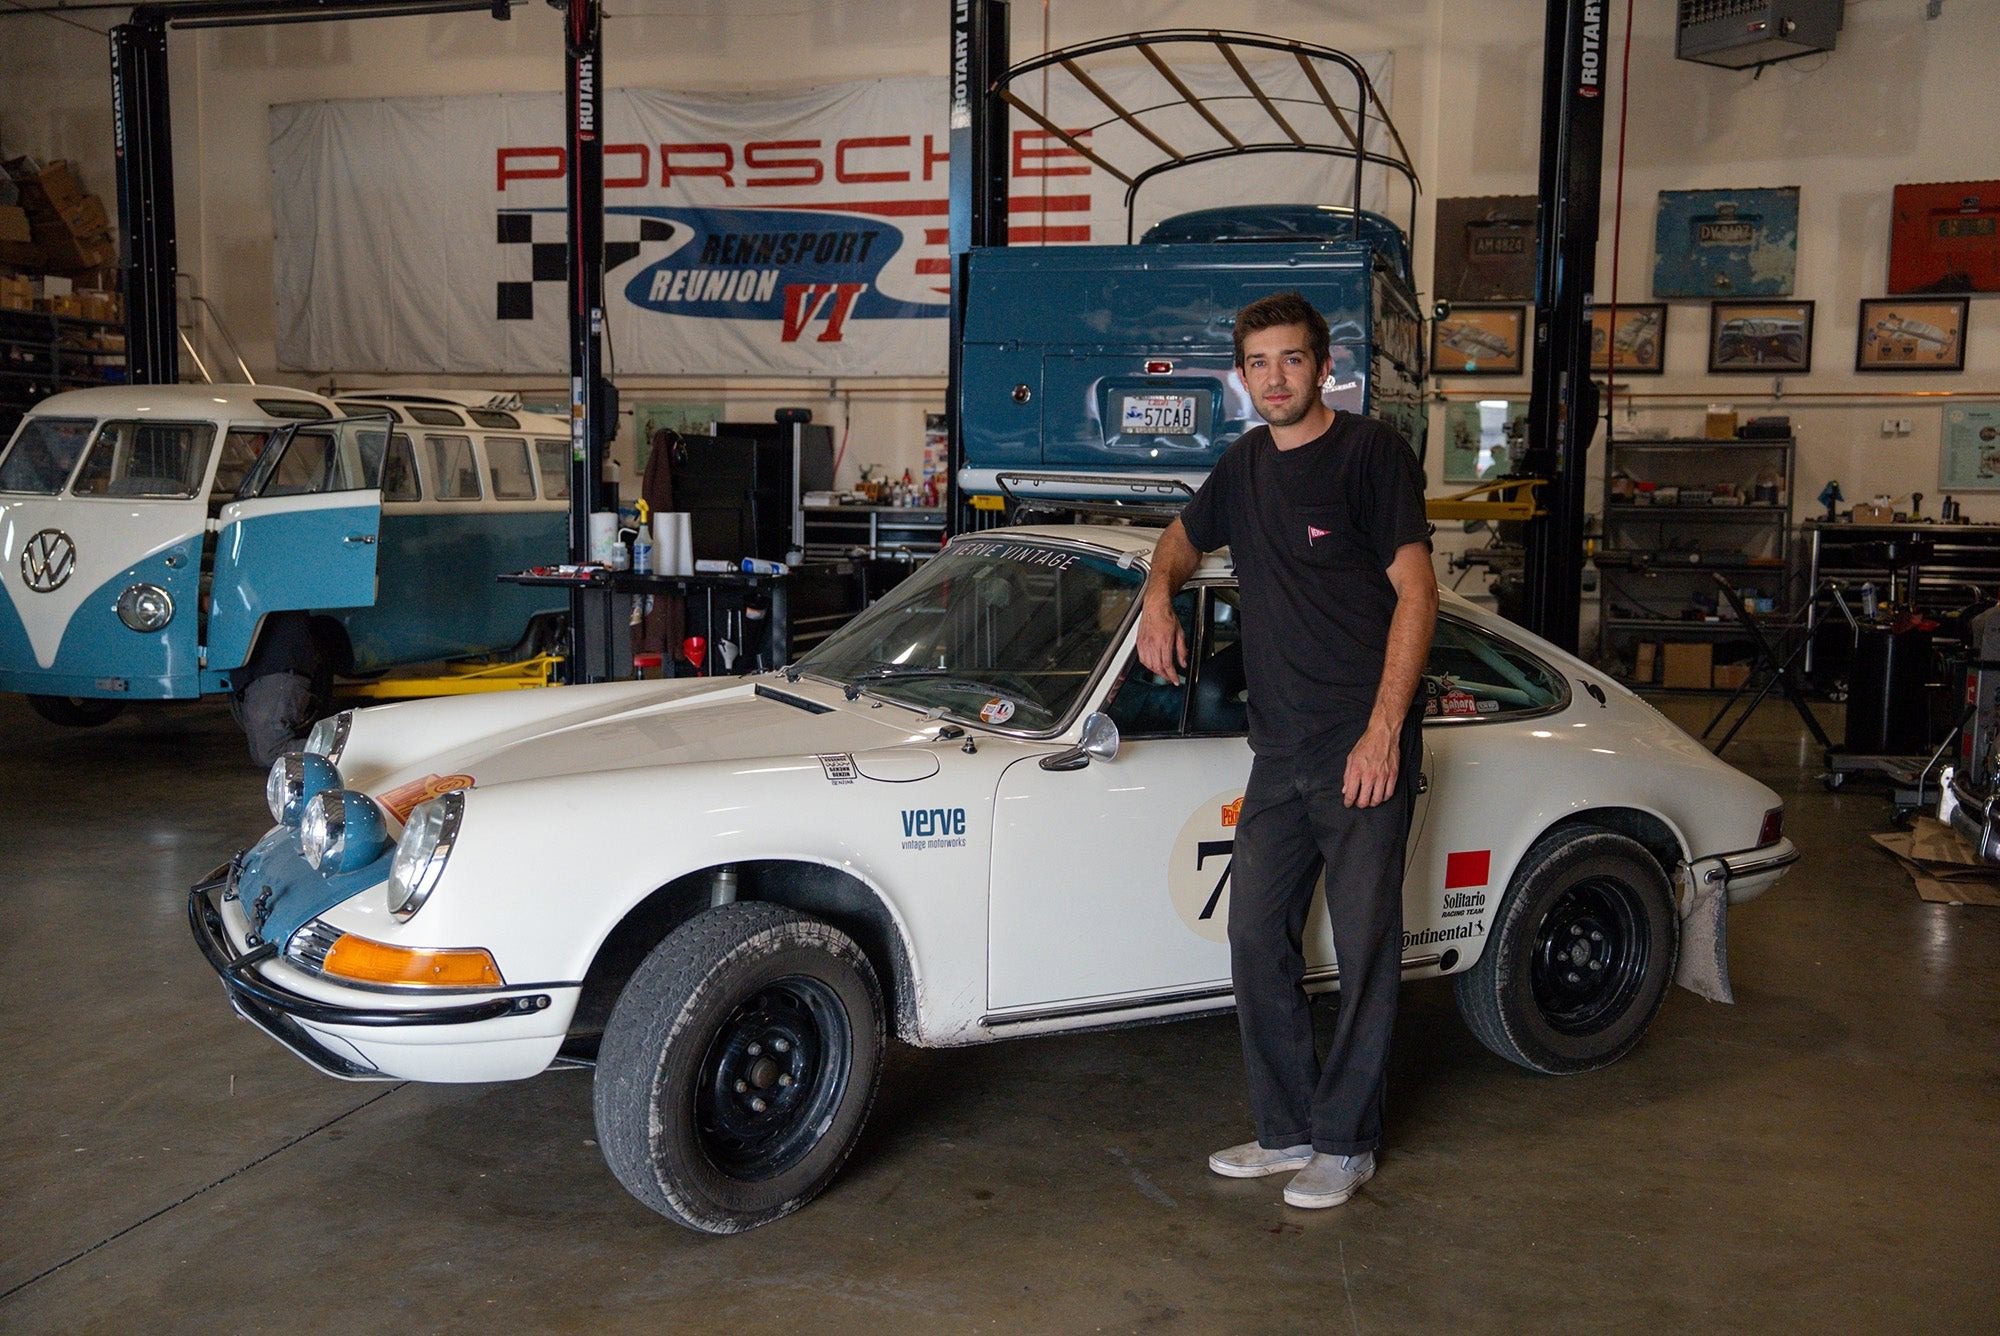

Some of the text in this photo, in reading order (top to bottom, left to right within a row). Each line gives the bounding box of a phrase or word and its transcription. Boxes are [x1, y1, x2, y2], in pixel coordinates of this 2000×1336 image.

[954, 30, 968, 113] ROTARY
[113, 74, 123, 147] ROTARY
[700, 231, 880, 265] RENNSPORT
[650, 269, 779, 302] REUNION
[781, 283, 868, 342] VI
[1145, 407, 1191, 427] 57CAB
[1000, 545, 1081, 571] VINTAGE
[901, 808, 966, 837] verve
[901, 838, 967, 851] vintage motorworks
[1441, 908, 1485, 918] RACING TEAM
[1443, 891, 1486, 909] Solitario
